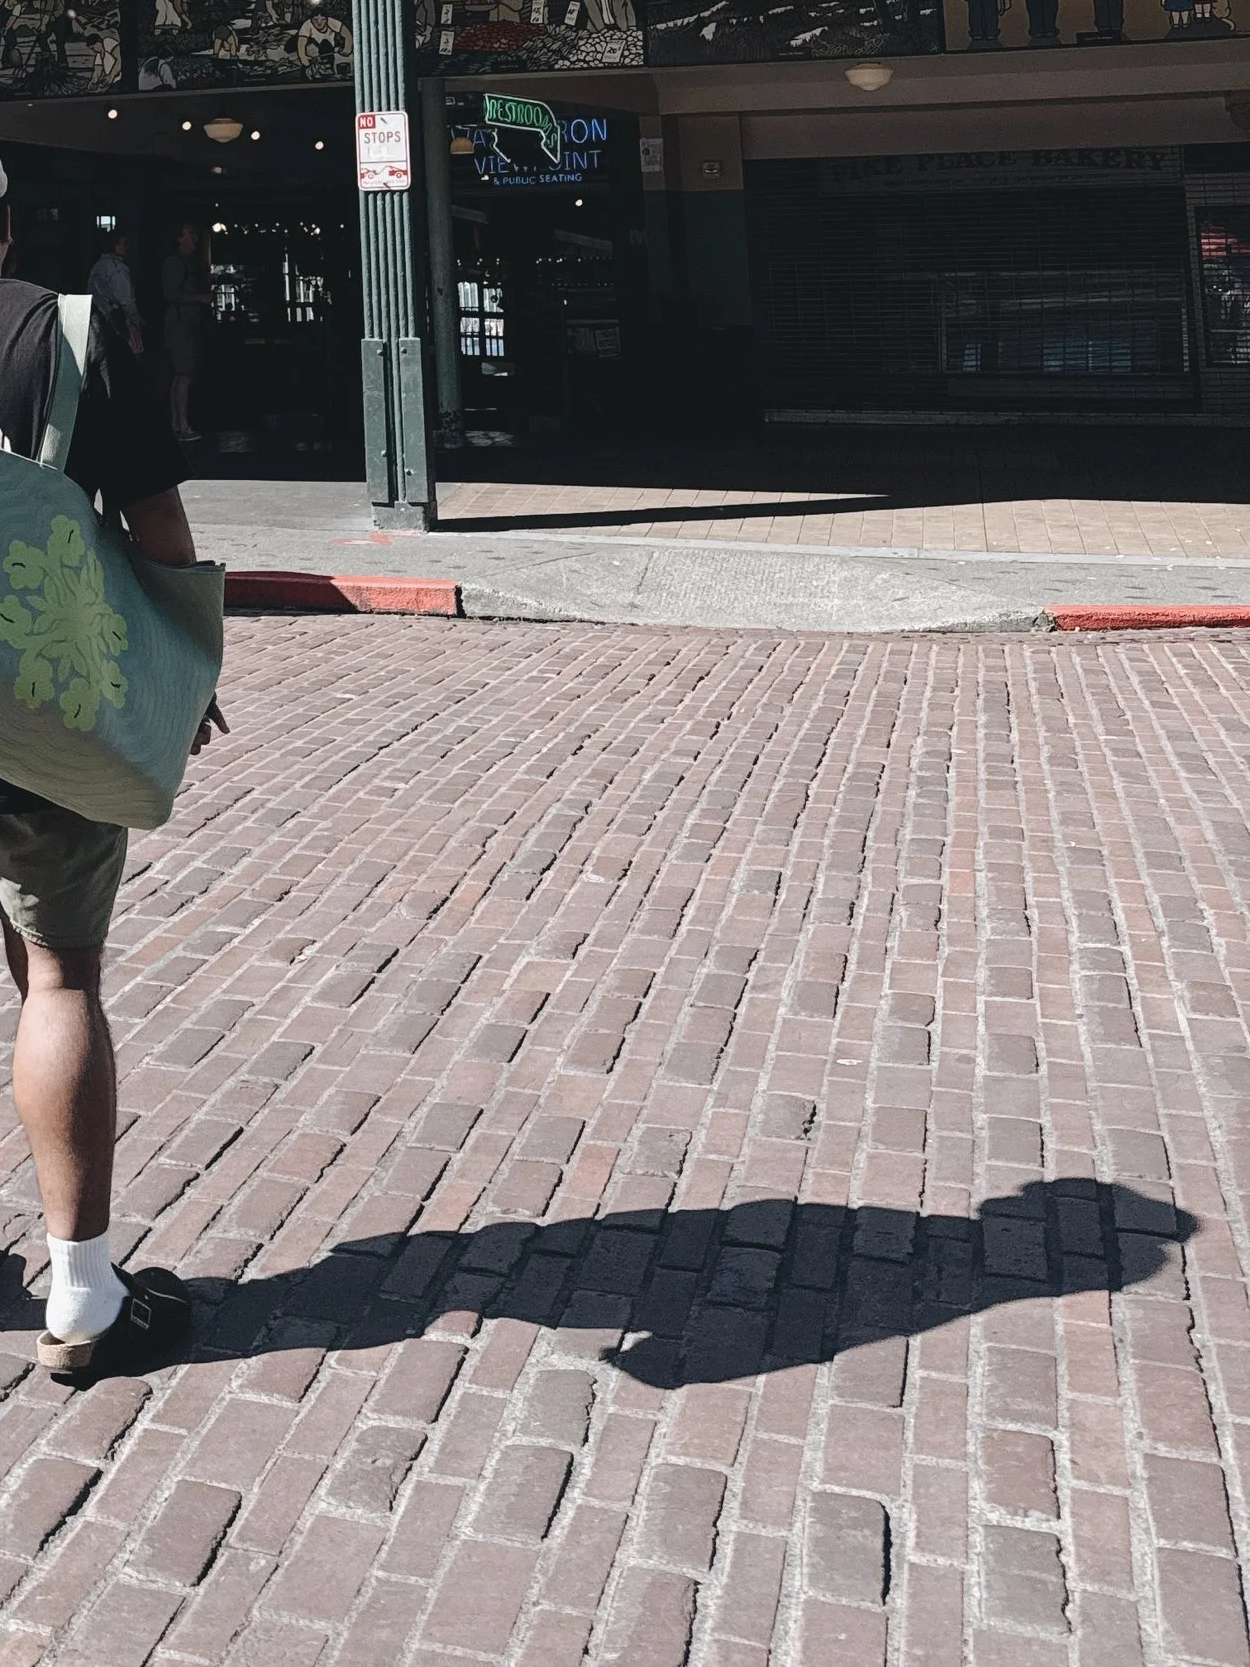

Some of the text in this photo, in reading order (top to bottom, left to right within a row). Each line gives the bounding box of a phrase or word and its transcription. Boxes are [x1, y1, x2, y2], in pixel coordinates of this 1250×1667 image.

[359, 116, 374, 128] NO
[364, 130, 401, 144] STOPS
[502, 174, 536, 185] PUBLIC
[539, 173, 583, 184] SEATING
